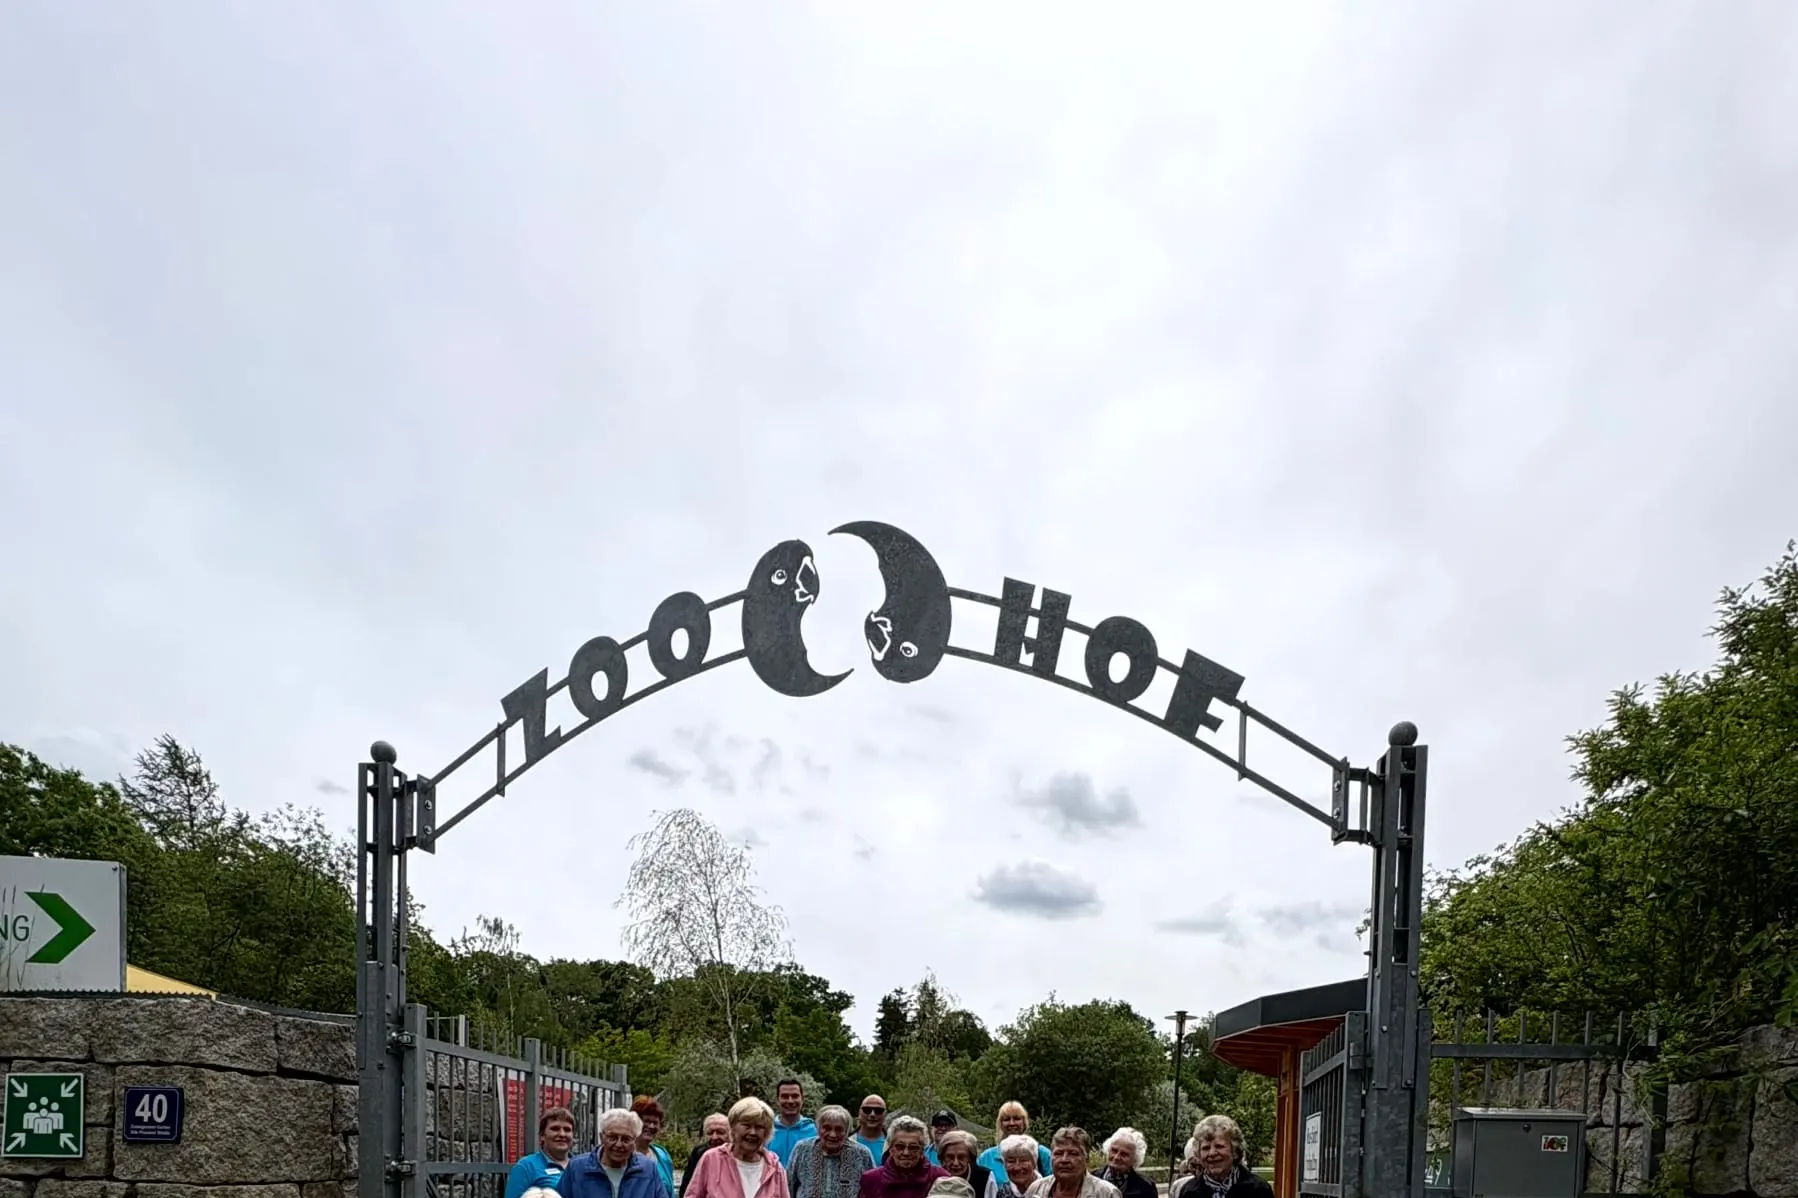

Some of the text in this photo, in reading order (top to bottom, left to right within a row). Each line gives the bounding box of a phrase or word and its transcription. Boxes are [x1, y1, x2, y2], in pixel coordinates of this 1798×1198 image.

[500, 576, 1246, 765] ZOO HOF
[135, 1093, 168, 1123] 40
